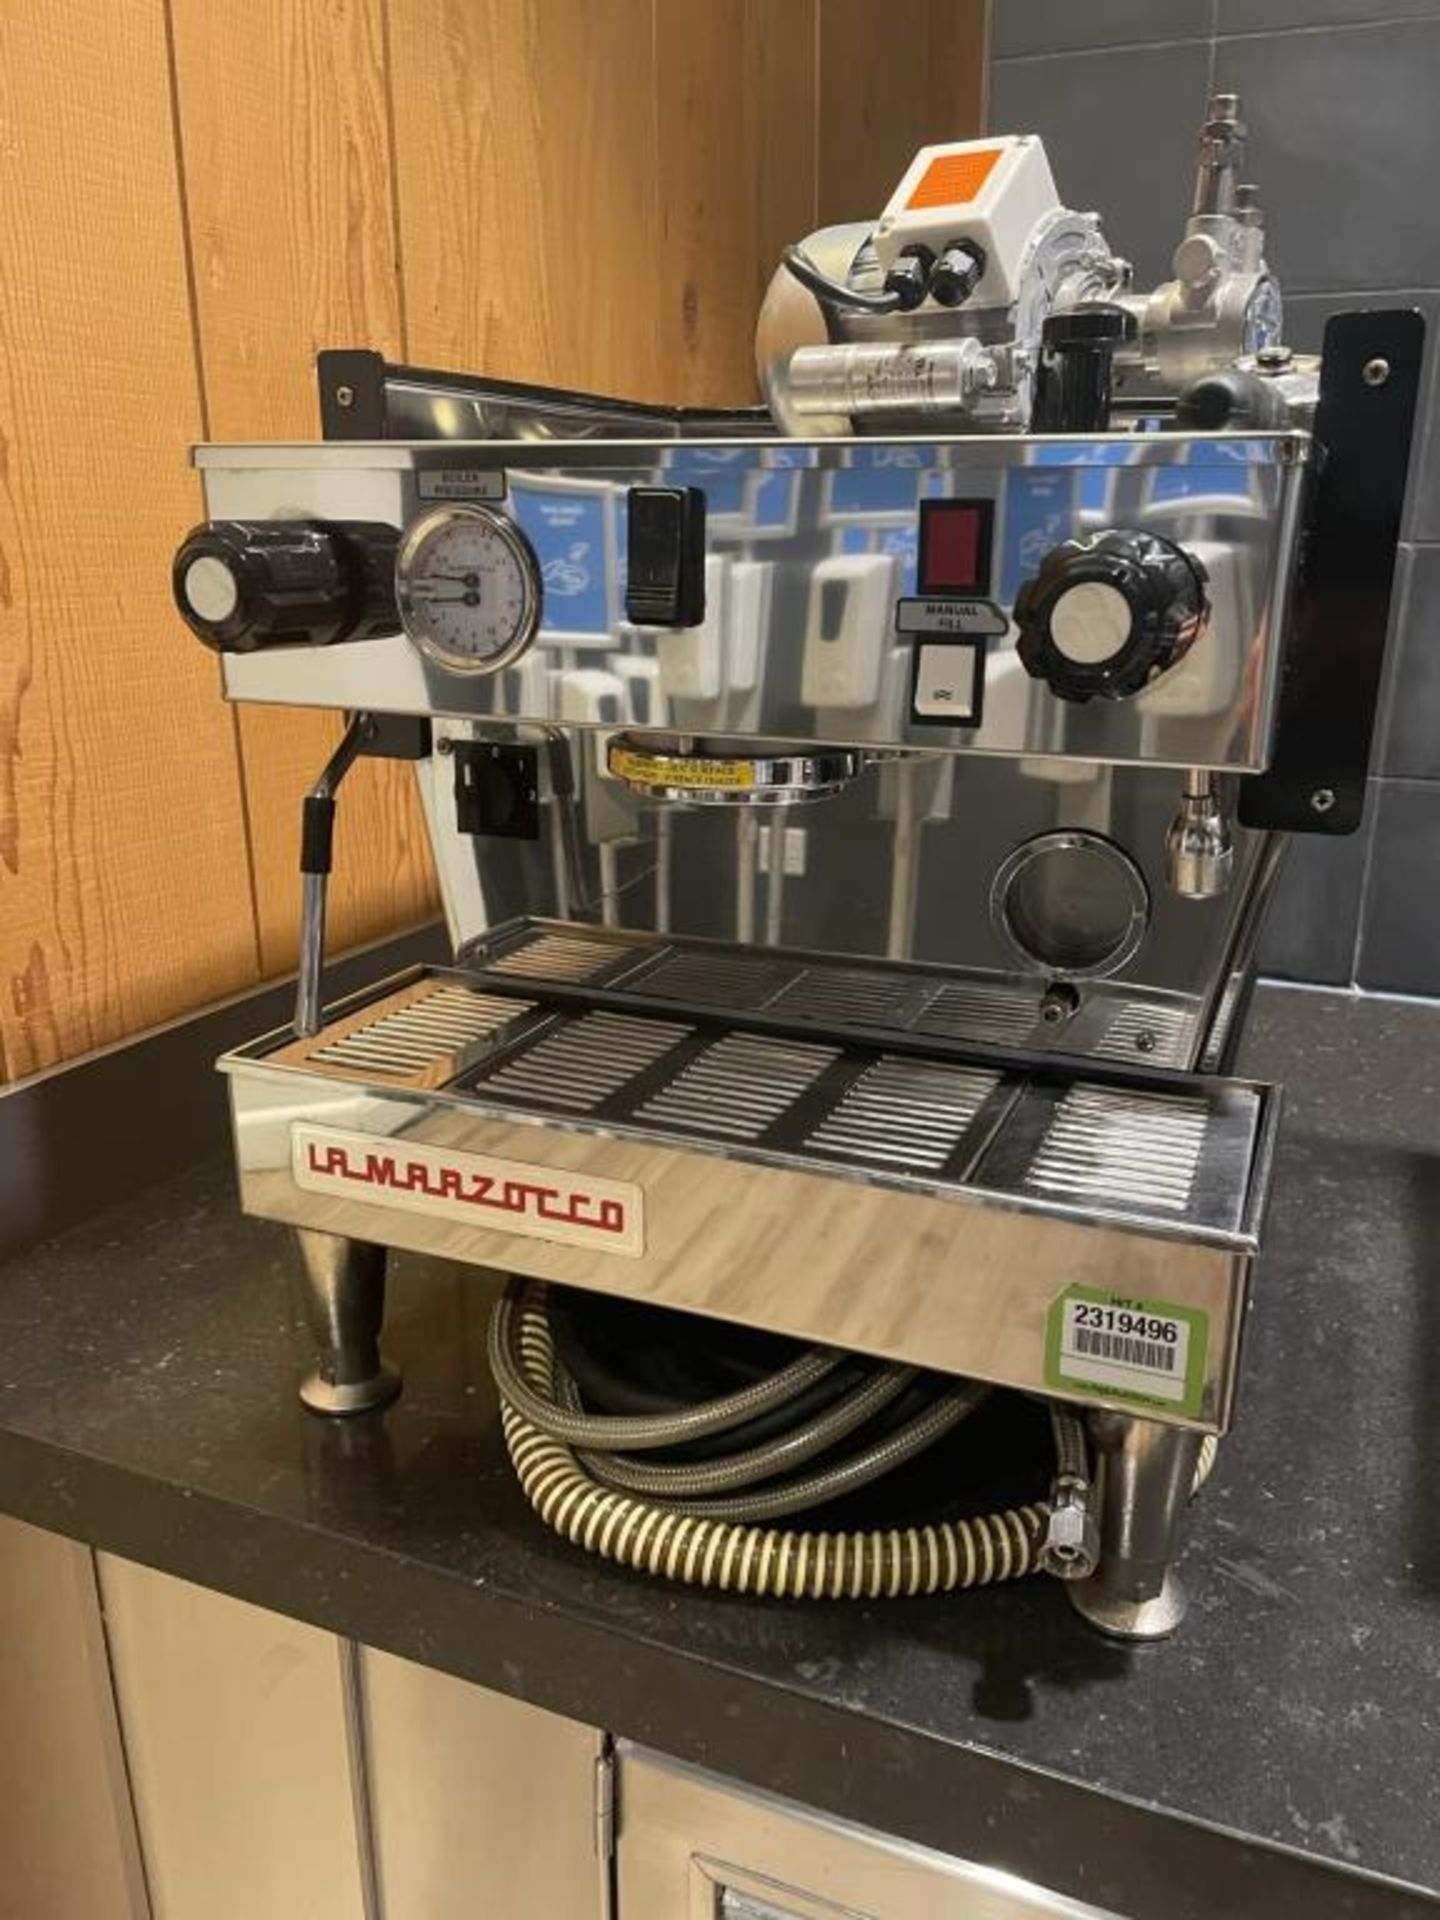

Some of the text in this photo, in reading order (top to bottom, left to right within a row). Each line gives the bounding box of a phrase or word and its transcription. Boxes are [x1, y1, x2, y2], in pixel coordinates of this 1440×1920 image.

[926, 604, 978, 616] MANUAL
[938, 618, 961, 629] FILL
[308, 1143, 624, 1233] LA MARZOCCO
[1074, 1303, 1178, 1344] 2319496
